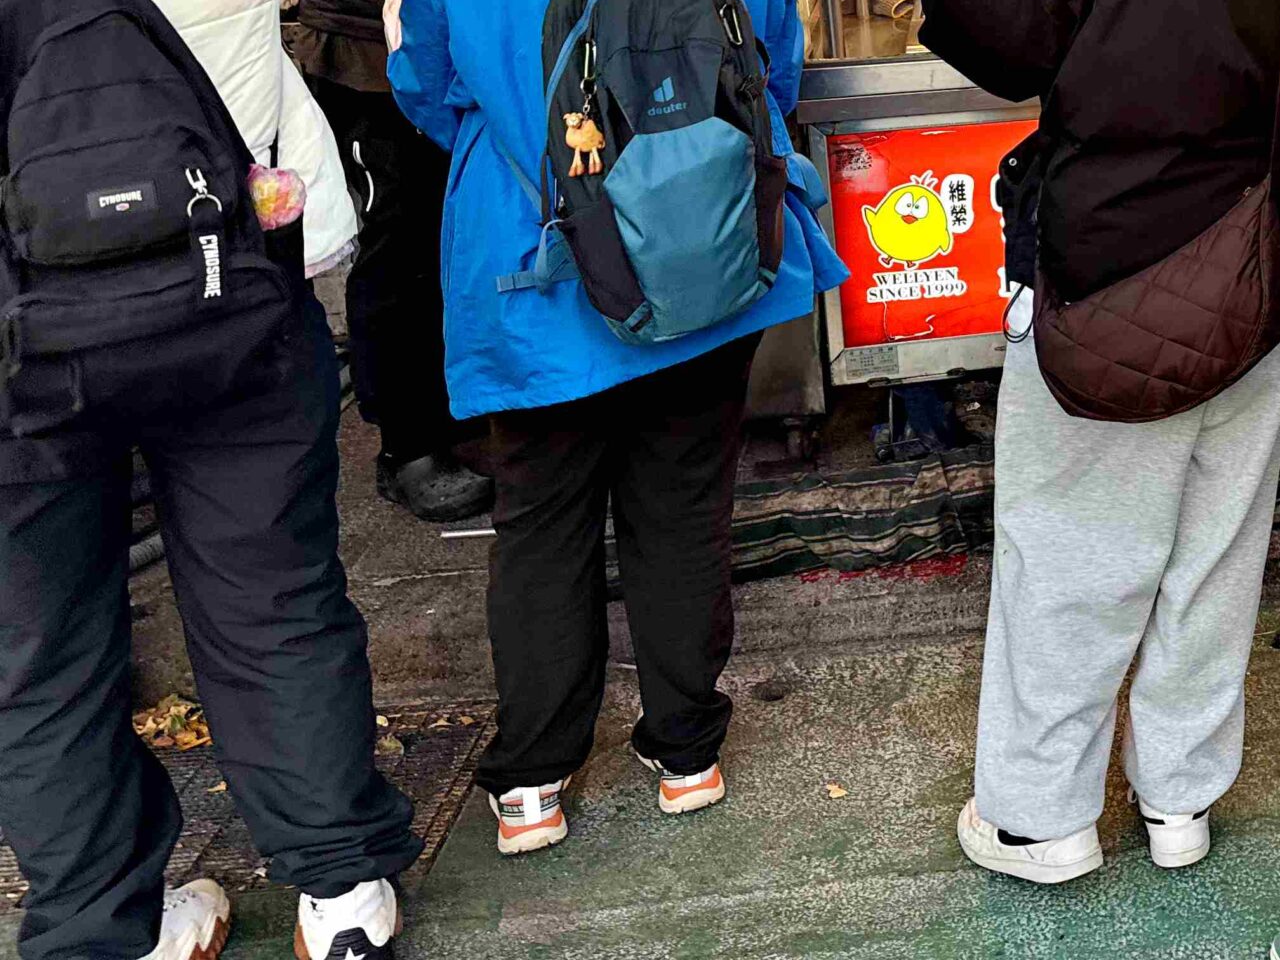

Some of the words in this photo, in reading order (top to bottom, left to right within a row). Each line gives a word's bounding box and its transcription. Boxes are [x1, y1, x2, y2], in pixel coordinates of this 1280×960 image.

[647, 102, 687, 116] deuter
[98, 190, 142, 208] CYNOSURE
[199, 234, 221, 298] CYNOSURE
[876, 269, 957, 286] WELLYEN
[869, 286, 919, 301] SINCE
[925, 282, 965, 297] 1999
